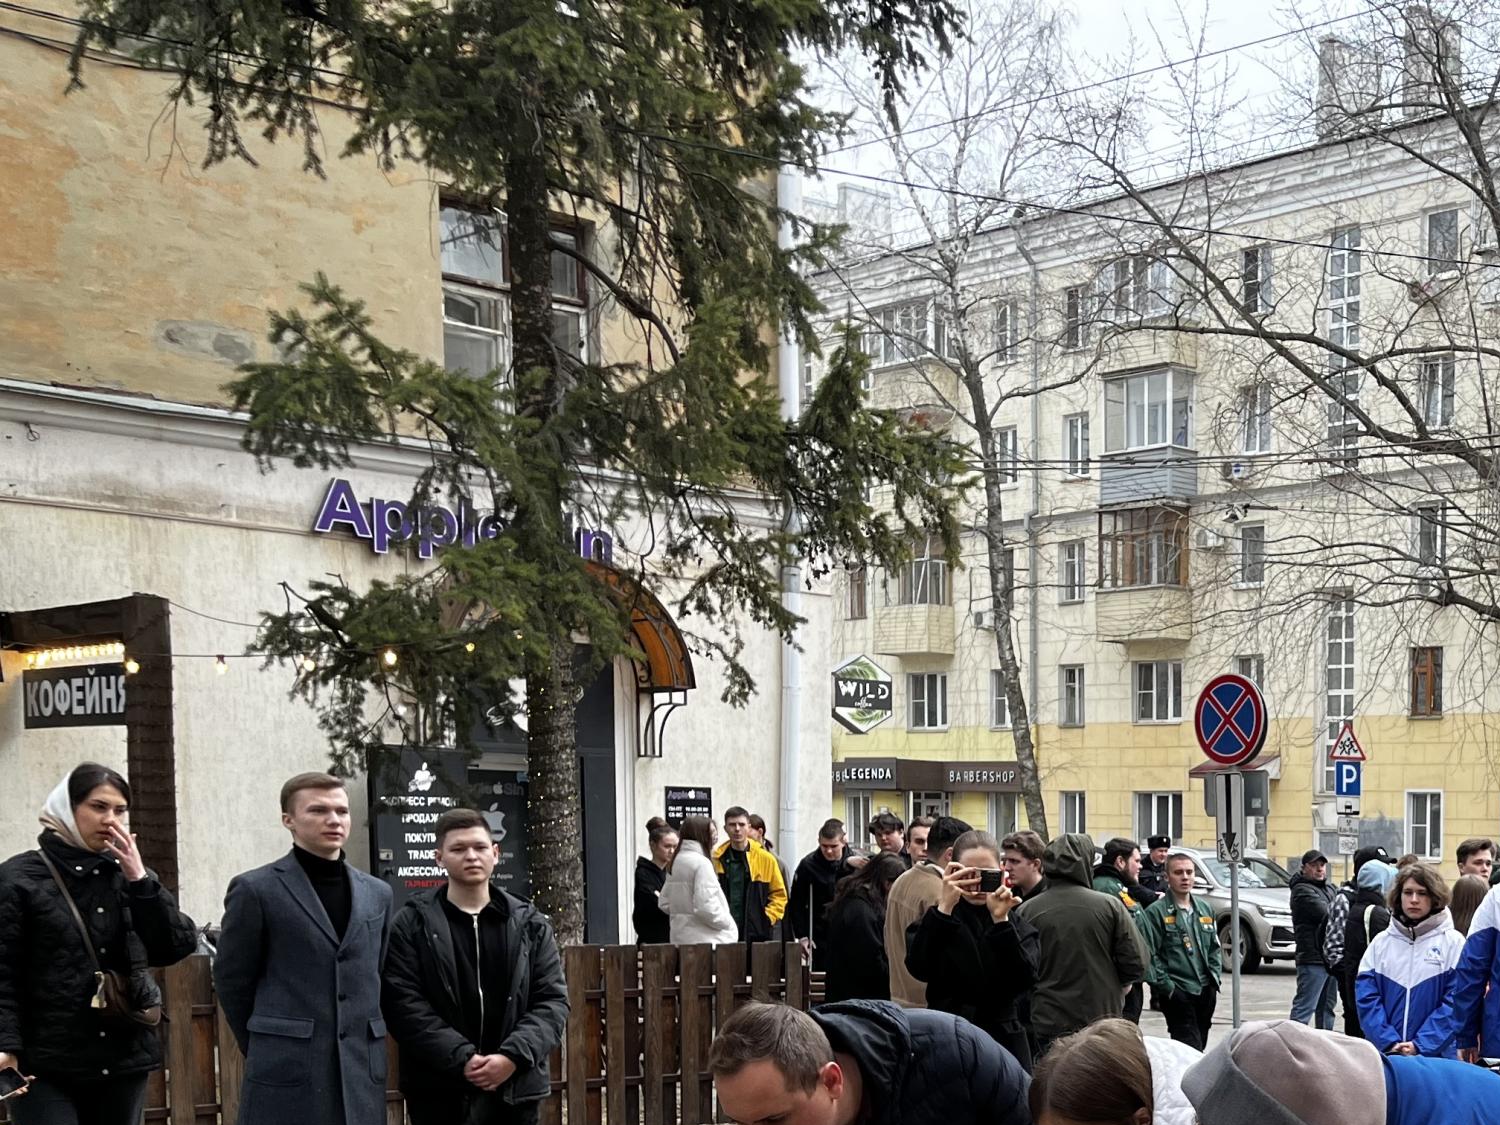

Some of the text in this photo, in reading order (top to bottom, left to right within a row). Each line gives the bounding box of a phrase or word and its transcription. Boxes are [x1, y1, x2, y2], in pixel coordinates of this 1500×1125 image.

[838, 680, 889, 700] WILD
[845, 767, 892, 780] LEGENDA
[950, 770, 1015, 783] BARBERSHOP
[1342, 764, 1358, 793] P
